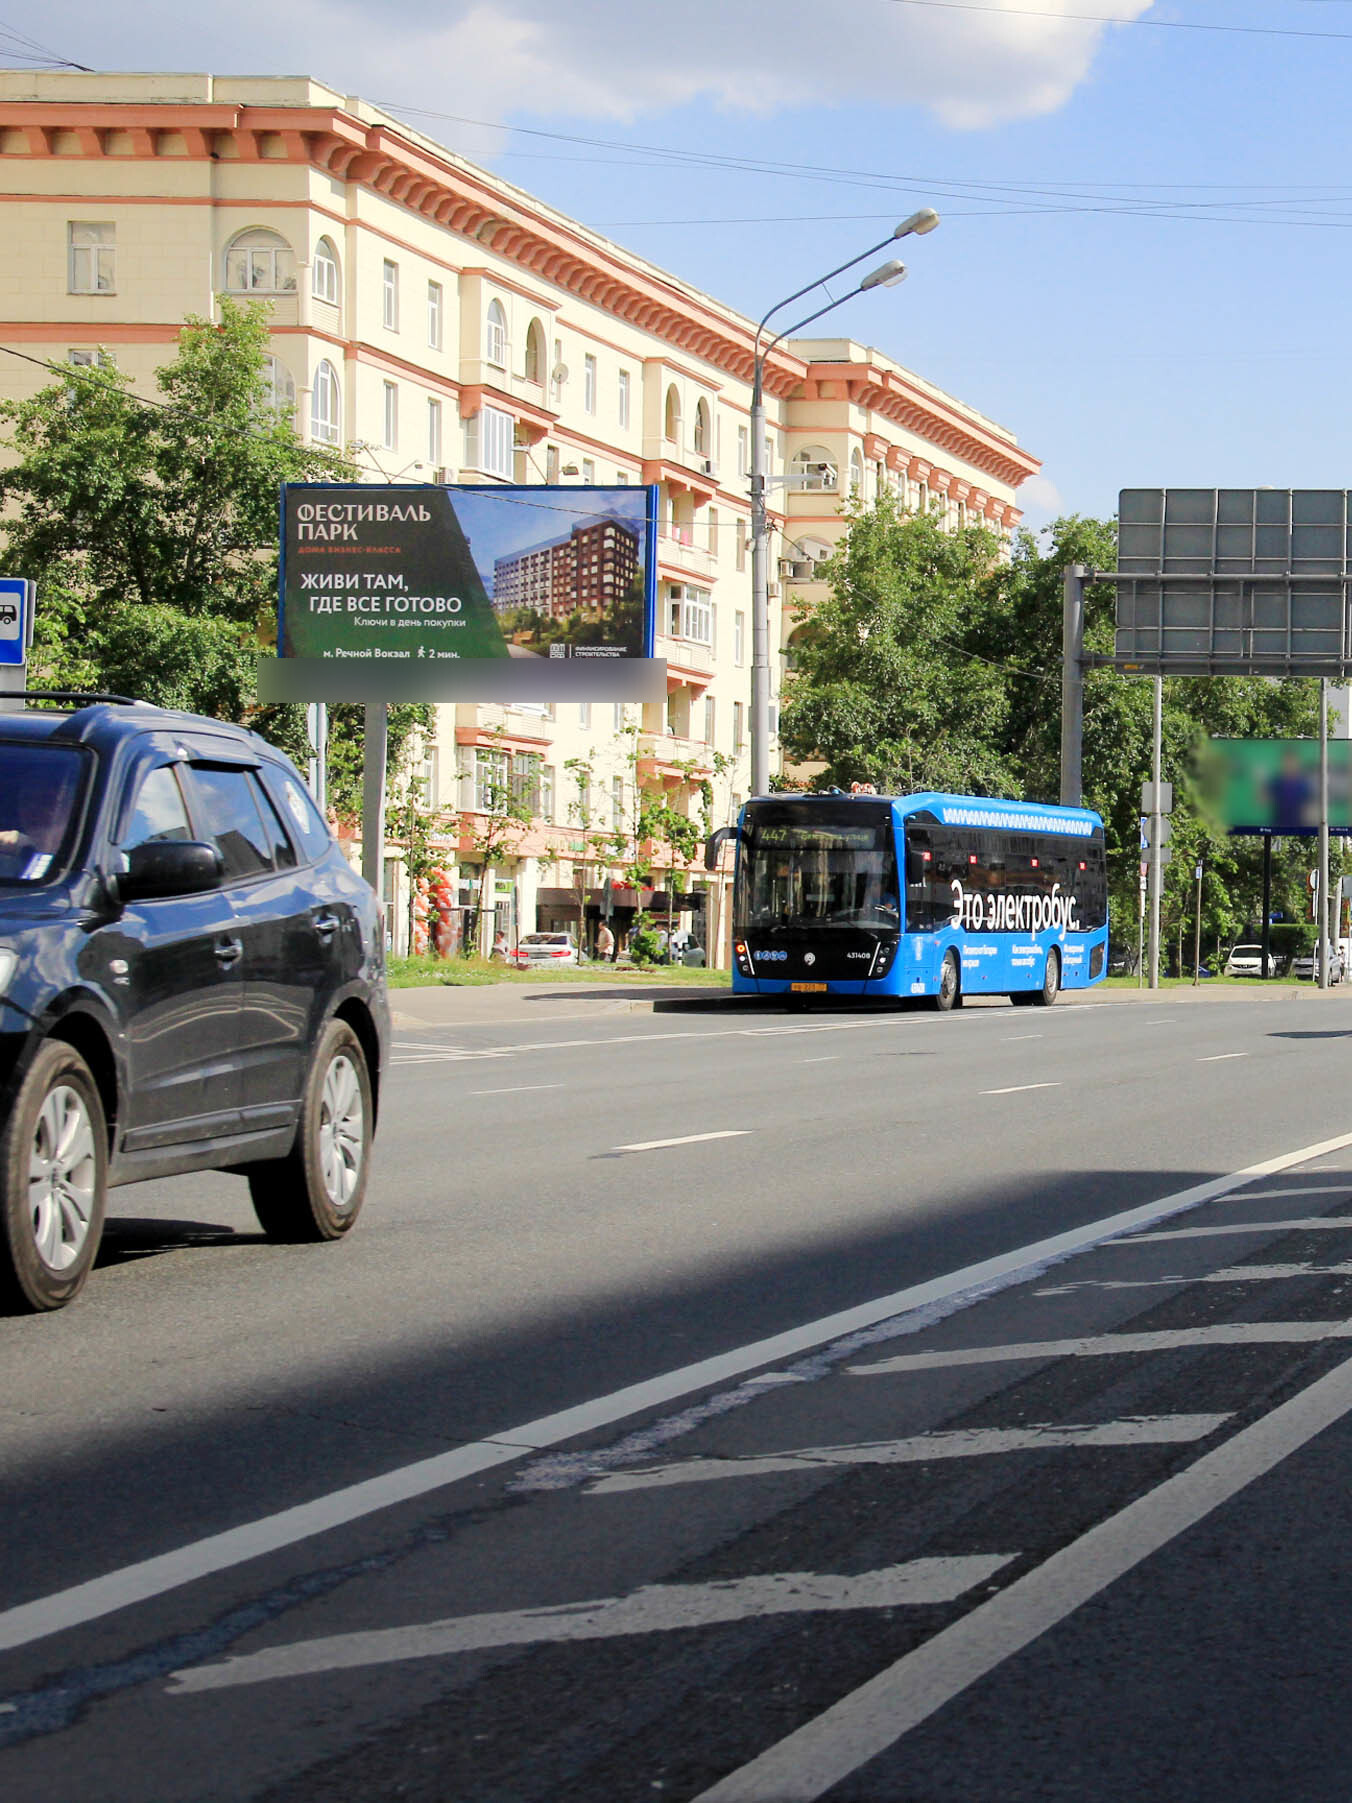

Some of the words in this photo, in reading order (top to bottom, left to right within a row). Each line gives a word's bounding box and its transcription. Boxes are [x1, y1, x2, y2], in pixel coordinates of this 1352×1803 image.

[296, 503, 432, 522] ФЕСТИВАЛЬ
[297, 523, 359, 541] ПАРК
[300, 573, 359, 590] ЖИВИ
[363, 573, 409, 592] ТАМ,
[309, 596, 342, 614] ГДЕ
[347, 596, 381, 612] ВСЕ
[386, 597, 462, 613] ГОТОВО
[353, 616, 388, 627] Ключи
[389, 619, 395, 627] в
[397, 619, 422, 628] день
[424, 619, 467, 629] покупки
[323, 650, 333, 658] м.
[335, 648, 372, 658] Речной
[374, 648, 410, 658] Вокзал
[429, 649, 435, 658] 2
[761, 829, 787, 841] 447
[951, 879, 984, 930] Это
[986, 883, 1080, 941] электробус.
